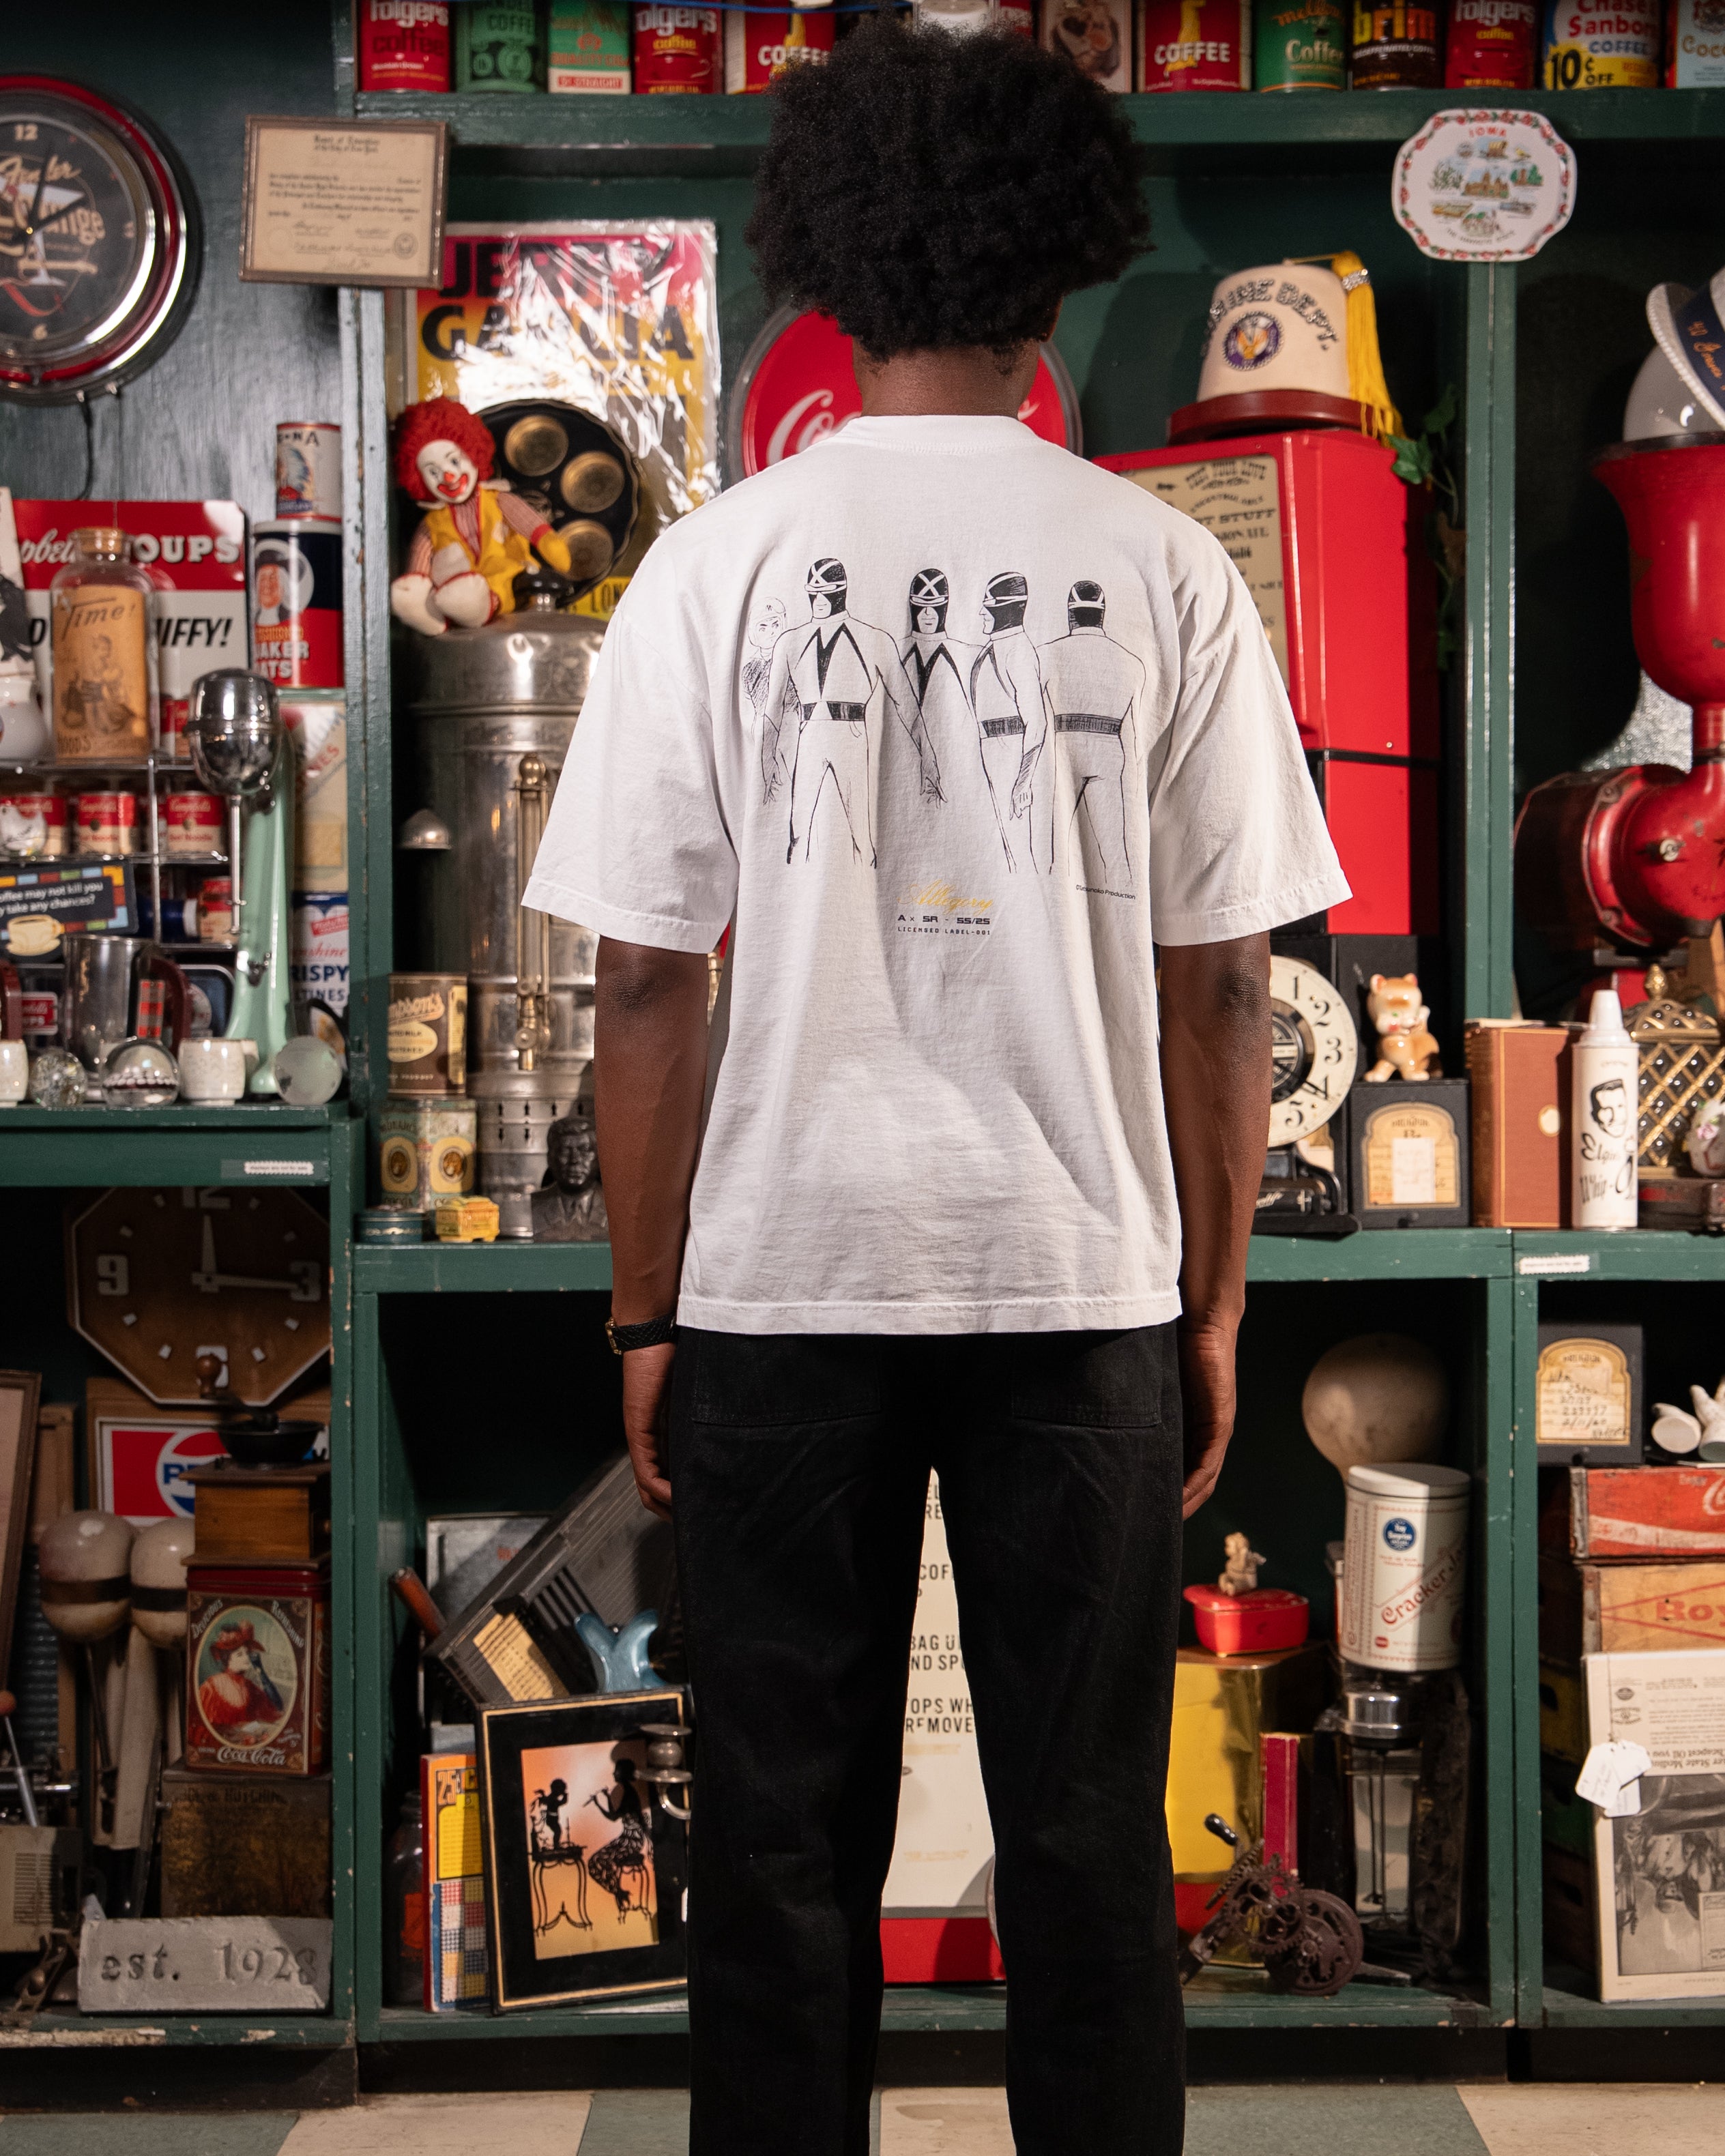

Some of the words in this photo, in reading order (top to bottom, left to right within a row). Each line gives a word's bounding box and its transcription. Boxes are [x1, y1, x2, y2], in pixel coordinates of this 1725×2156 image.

[1154, 41, 1231, 65] COFFEE
[1550, 49, 1582, 89] 10
[1585, 73, 1614, 85] OFF
[15, 123, 38, 141] 12
[5, 903, 29, 915] take
[29, 901, 49, 913] any
[48, 892, 96, 909] chances?
[25, 888, 47, 900] may
[48, 886, 66, 897] not
[68, 882, 83, 894] kill
[83, 882, 104, 894] you
[1105, 889, 1136, 900] Production
[1292, 975, 1299, 1001] 1
[1314, 1000, 1330, 1027] 2
[1324, 1036, 1342, 1066] 3
[1300, 1074, 1329, 1101] 4
[1285, 1099, 1304, 1126] 5
[98, 1255, 130, 1296] 9
[289, 1261, 321, 1302] 3
[919, 1564, 955, 1580] COF
[1380, 1568, 1447, 1625] Cracker
[909, 1655, 933, 1671] ND
[908, 1698, 944, 1715] OPS
[101, 1942, 181, 1981] est.
